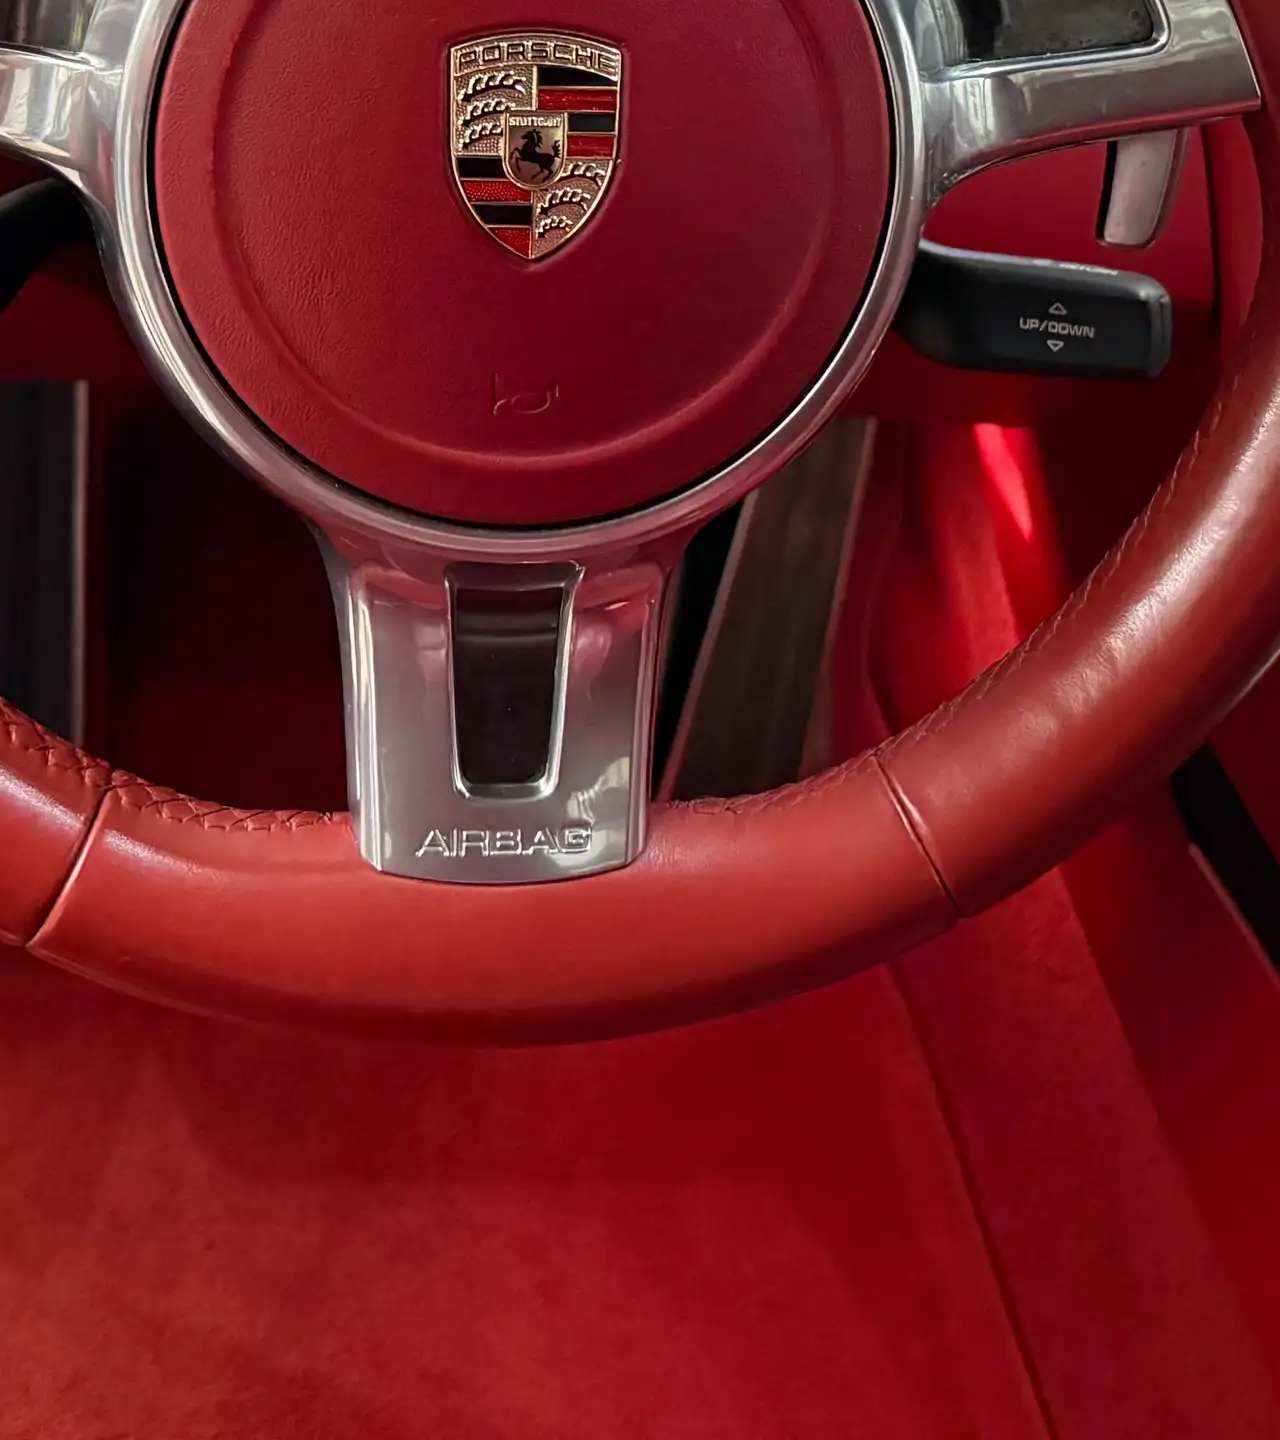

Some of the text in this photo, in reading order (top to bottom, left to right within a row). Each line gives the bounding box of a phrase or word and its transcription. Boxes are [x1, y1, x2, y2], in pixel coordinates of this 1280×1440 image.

[456, 41, 619, 74] PORSCHE
[1019, 317, 1096, 339] UP/DOWN
[413, 824, 593, 858] AIRBAG
